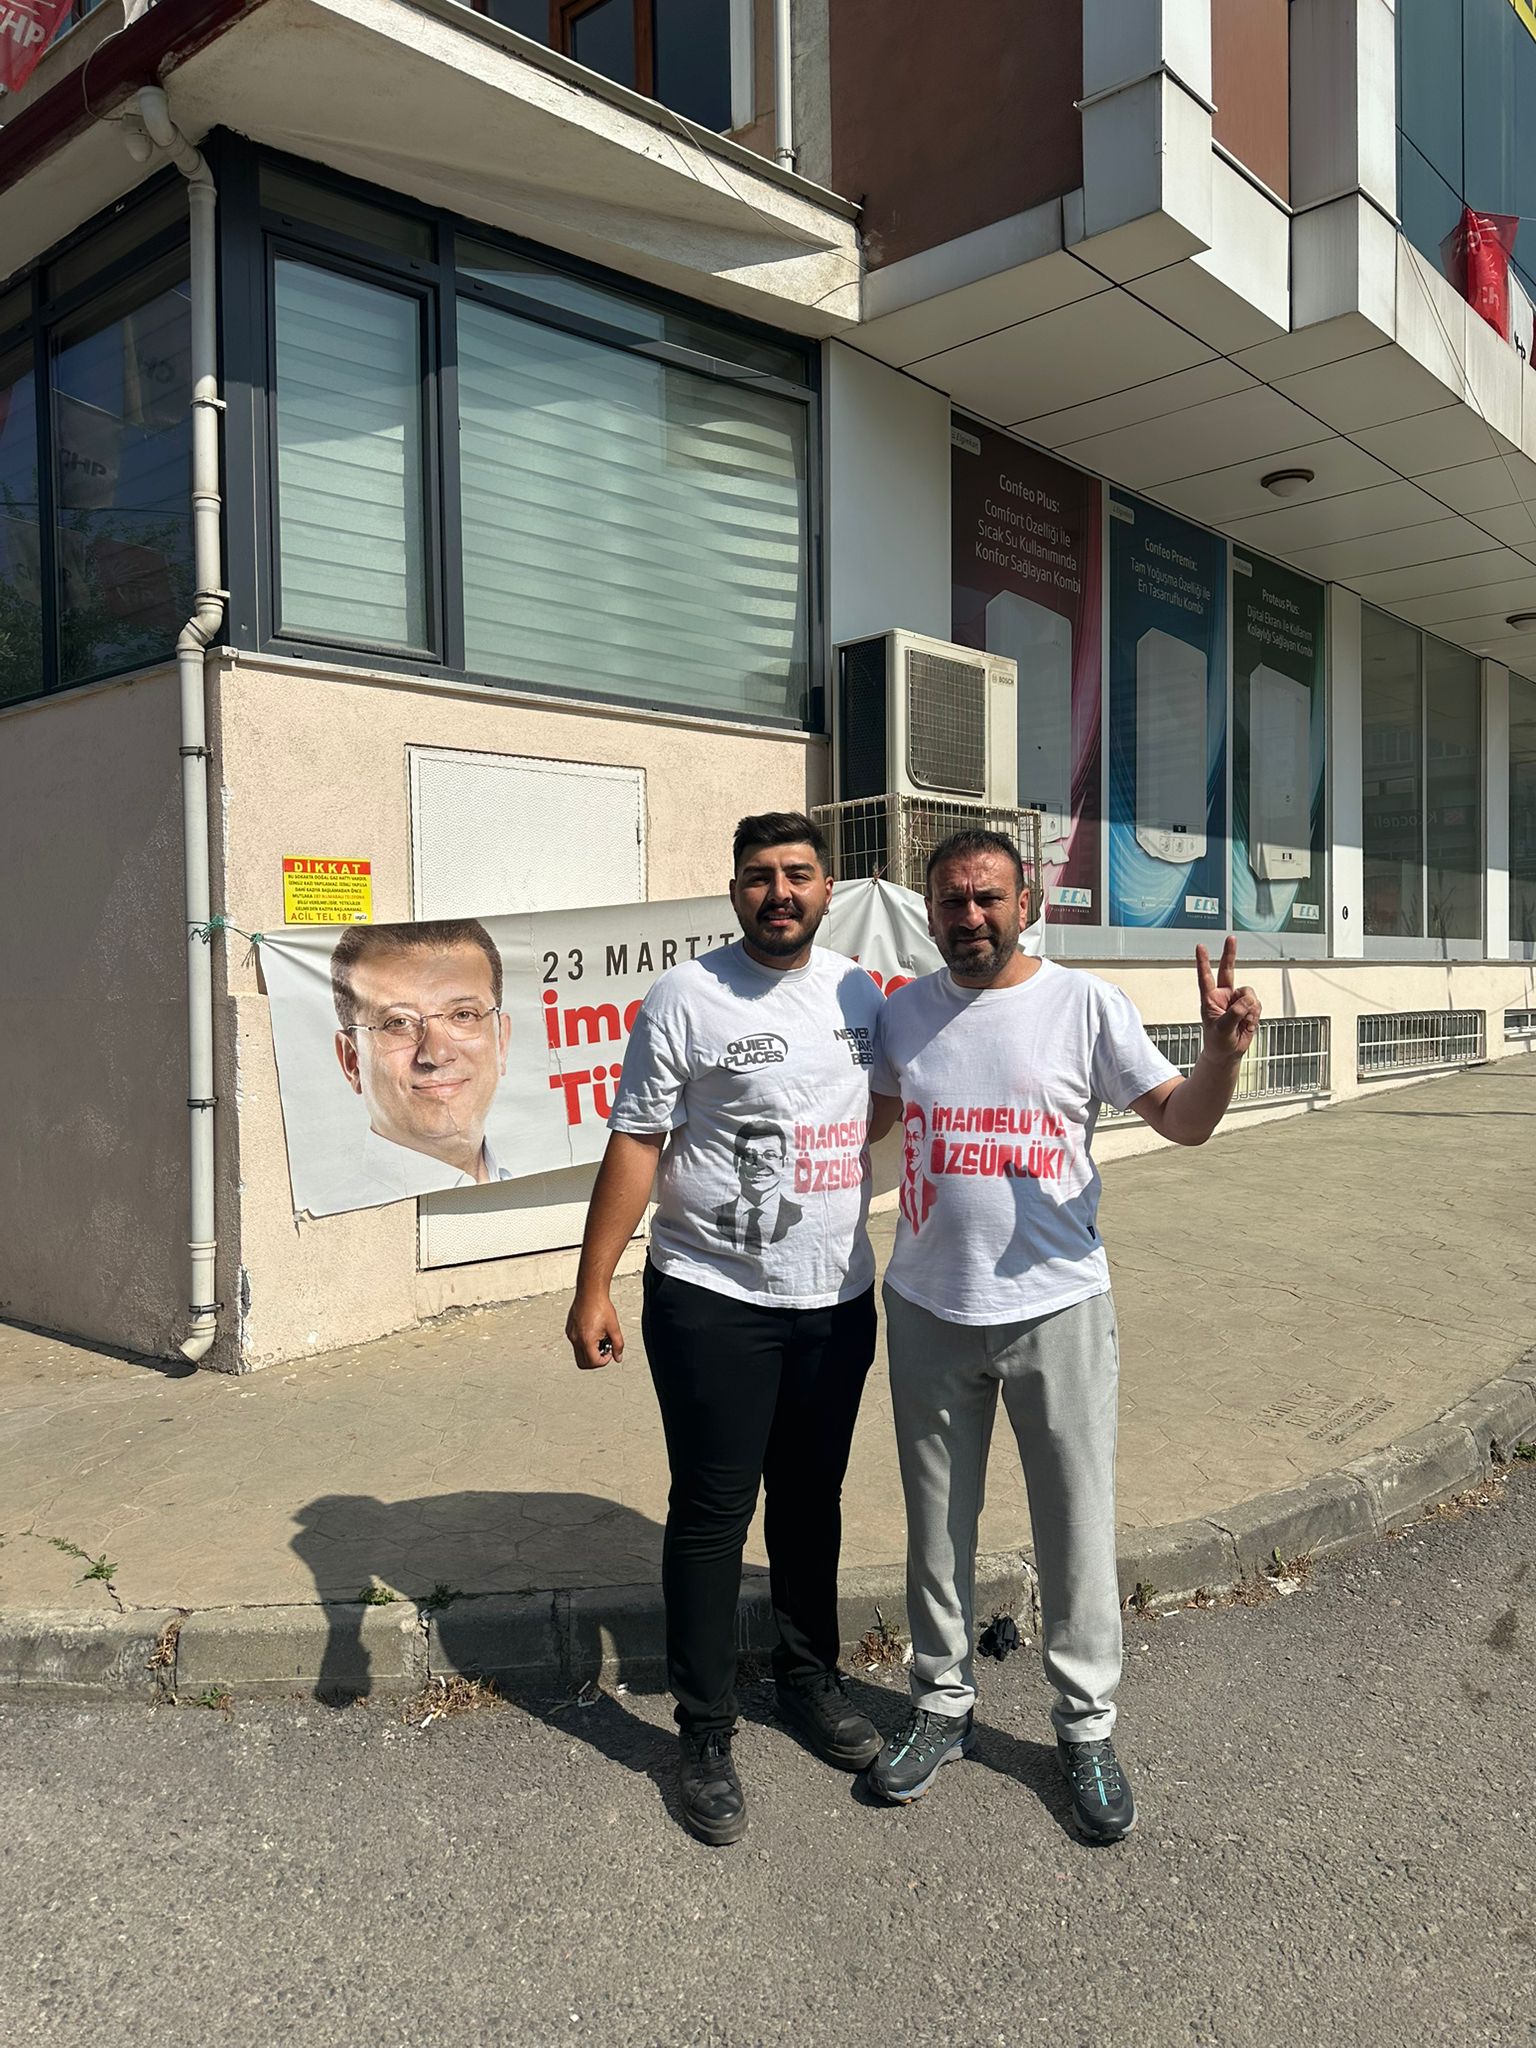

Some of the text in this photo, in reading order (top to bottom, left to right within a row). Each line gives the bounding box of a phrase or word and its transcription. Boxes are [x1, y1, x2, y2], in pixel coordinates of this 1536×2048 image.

[0, 5, 46, 48] HP
[999, 474, 1060, 513] Confeo Plus:
[985, 499, 1025, 530] Comfort
[1025, 512, 1059, 545] Özelliği
[978, 519, 1077, 571] Sıcak Su Kullanımında
[1144, 538, 1171, 560] Confeo
[975, 541, 1081, 594] Konfor Sağlayan Kombi
[1130, 557, 1146, 576] Tam
[1138, 578, 1148, 594] En
[998, 675, 1014, 685] BOSCH
[294, 860, 361, 874] DİKKAT
[291, 911, 352, 921] ACİL TEL 187
[543, 949, 584, 983] 23
[727, 1038, 774, 1055] QUIET
[724, 1050, 784, 1068] PLACES
